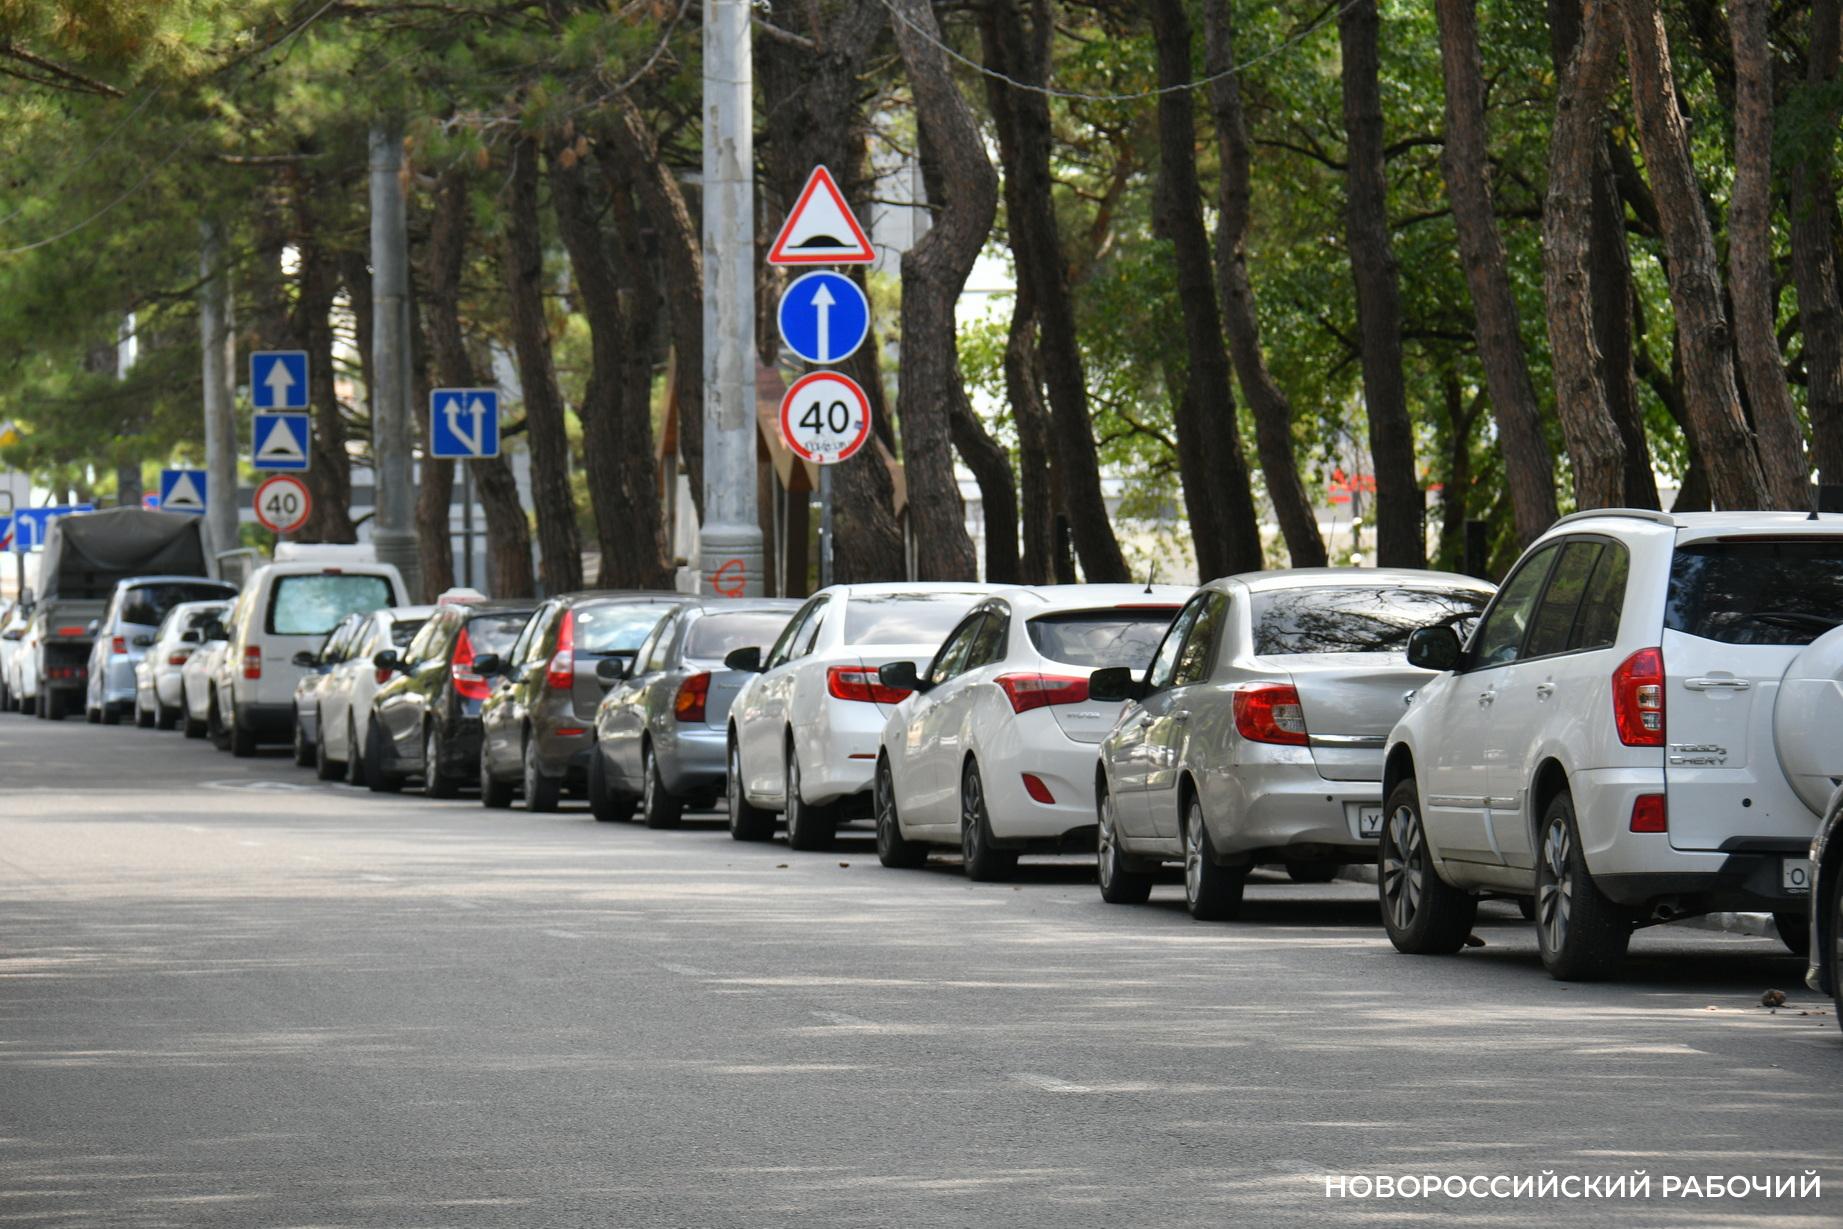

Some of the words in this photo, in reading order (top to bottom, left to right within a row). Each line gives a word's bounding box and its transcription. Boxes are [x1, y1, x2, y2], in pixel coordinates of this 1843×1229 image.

[799, 400, 849, 434] 40
[266, 493, 297, 514] 40
[1670, 756, 1728, 765] CHERY
